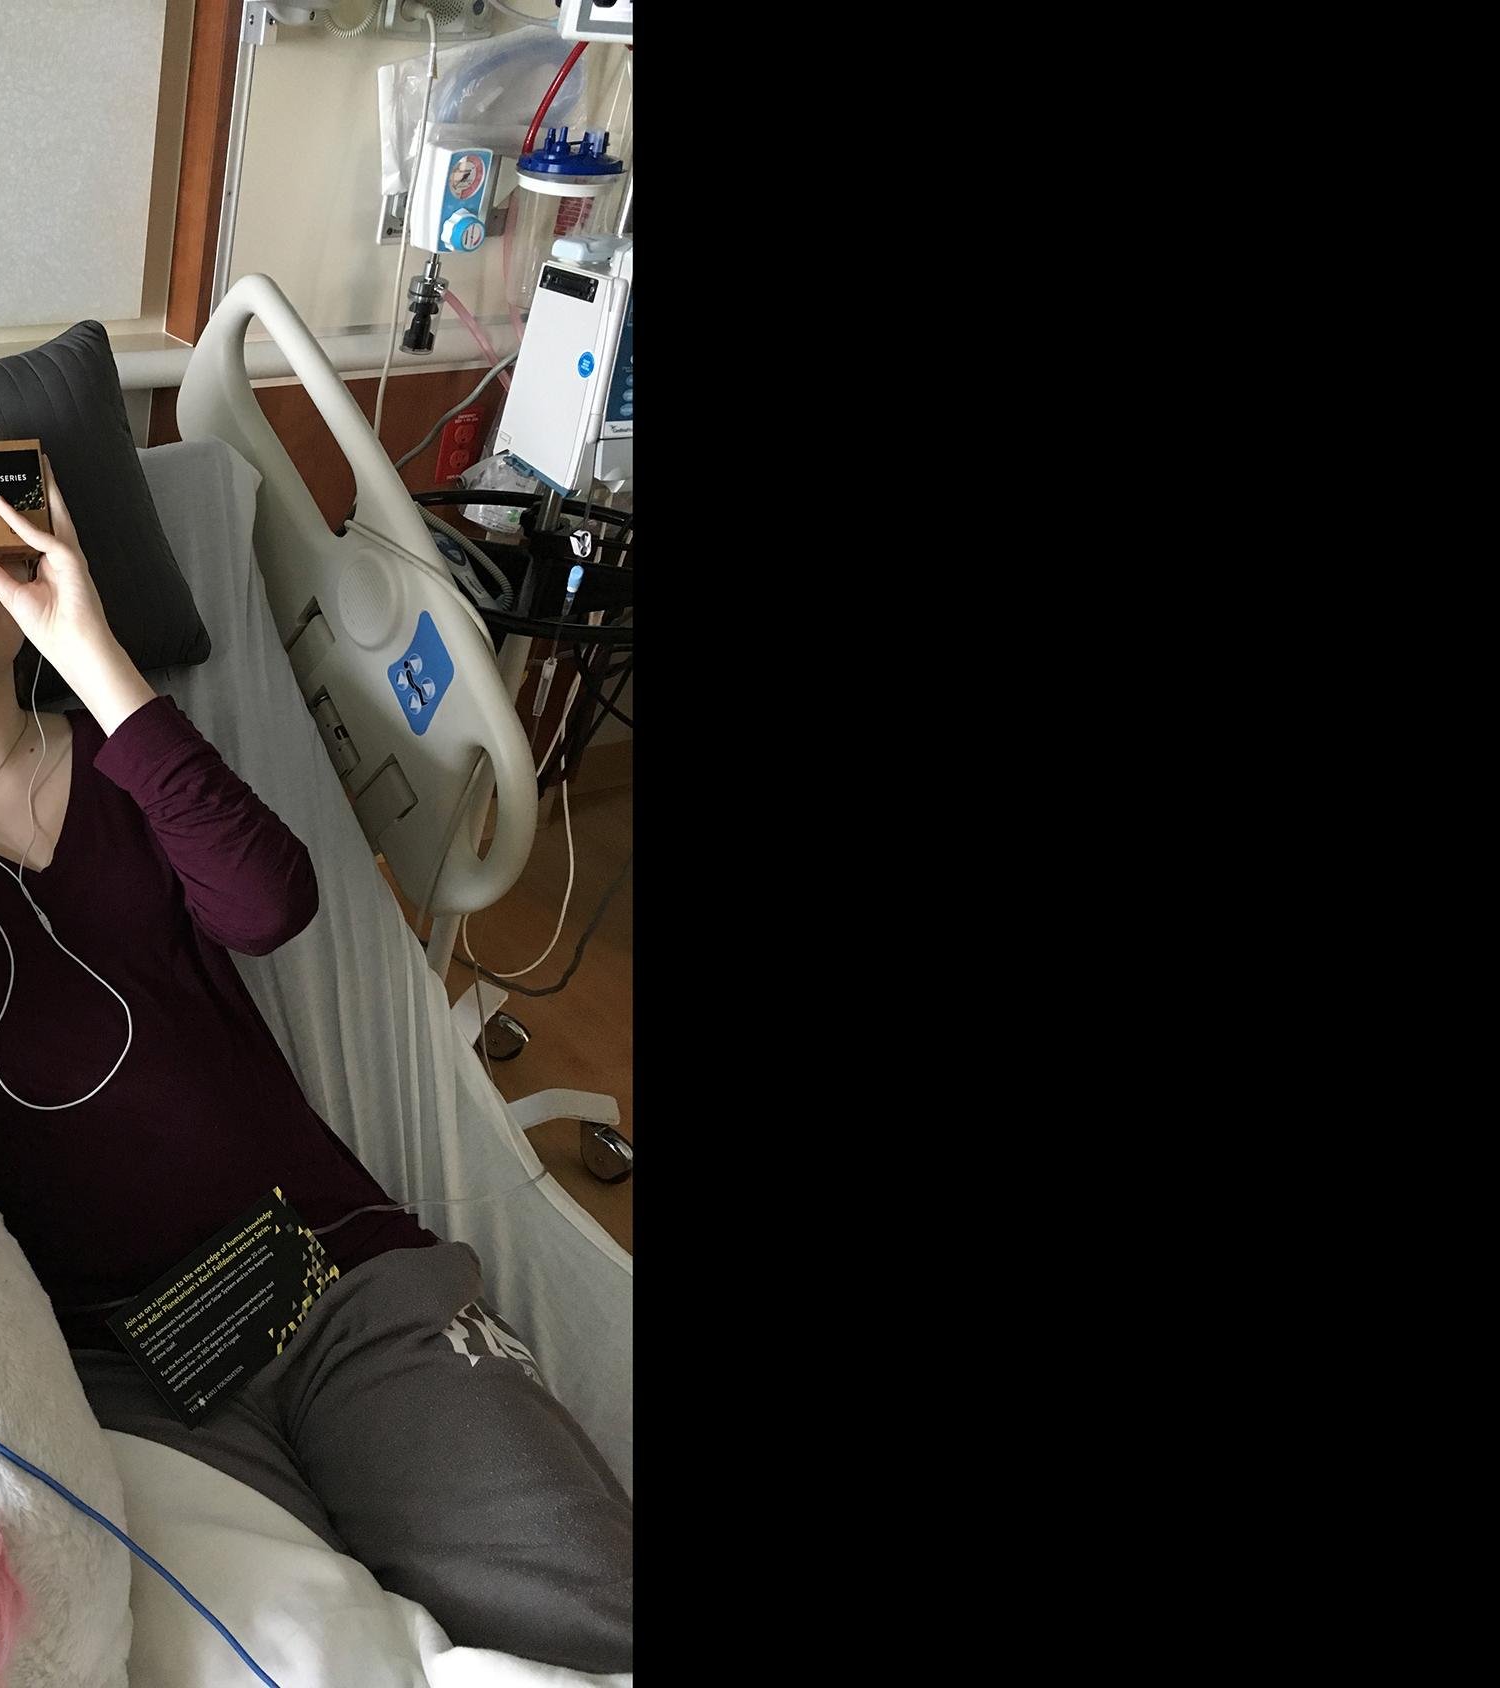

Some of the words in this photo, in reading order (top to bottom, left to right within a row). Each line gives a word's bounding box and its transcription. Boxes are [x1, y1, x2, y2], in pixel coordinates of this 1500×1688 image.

[0, 473, 27, 483] SERIES
[123, 1317, 138, 1330] Join
[136, 1311, 145, 1320] us
[143, 1305, 153, 1314] on
[154, 1284, 178, 1307] journey
[175, 1280, 185, 1289] to
[182, 1272, 195, 1283] the
[192, 1261, 208, 1275] very
[205, 1251, 222, 1265] edge
[219, 1243, 228, 1254] of
[225, 1231, 247, 1248] human
[243, 1209, 274, 1234] knowledge
[129, 1330, 139, 1339] in
[136, 1322, 149, 1334] the
[147, 1309, 164, 1326] Adler
[161, 1281, 200, 1313] Planetarium's
[197, 1268, 214, 1285] Kavli
[211, 1251, 238, 1274] Fulldome
[234, 1236, 256, 1255] Lecture
[253, 1224, 272, 1240] Series.
